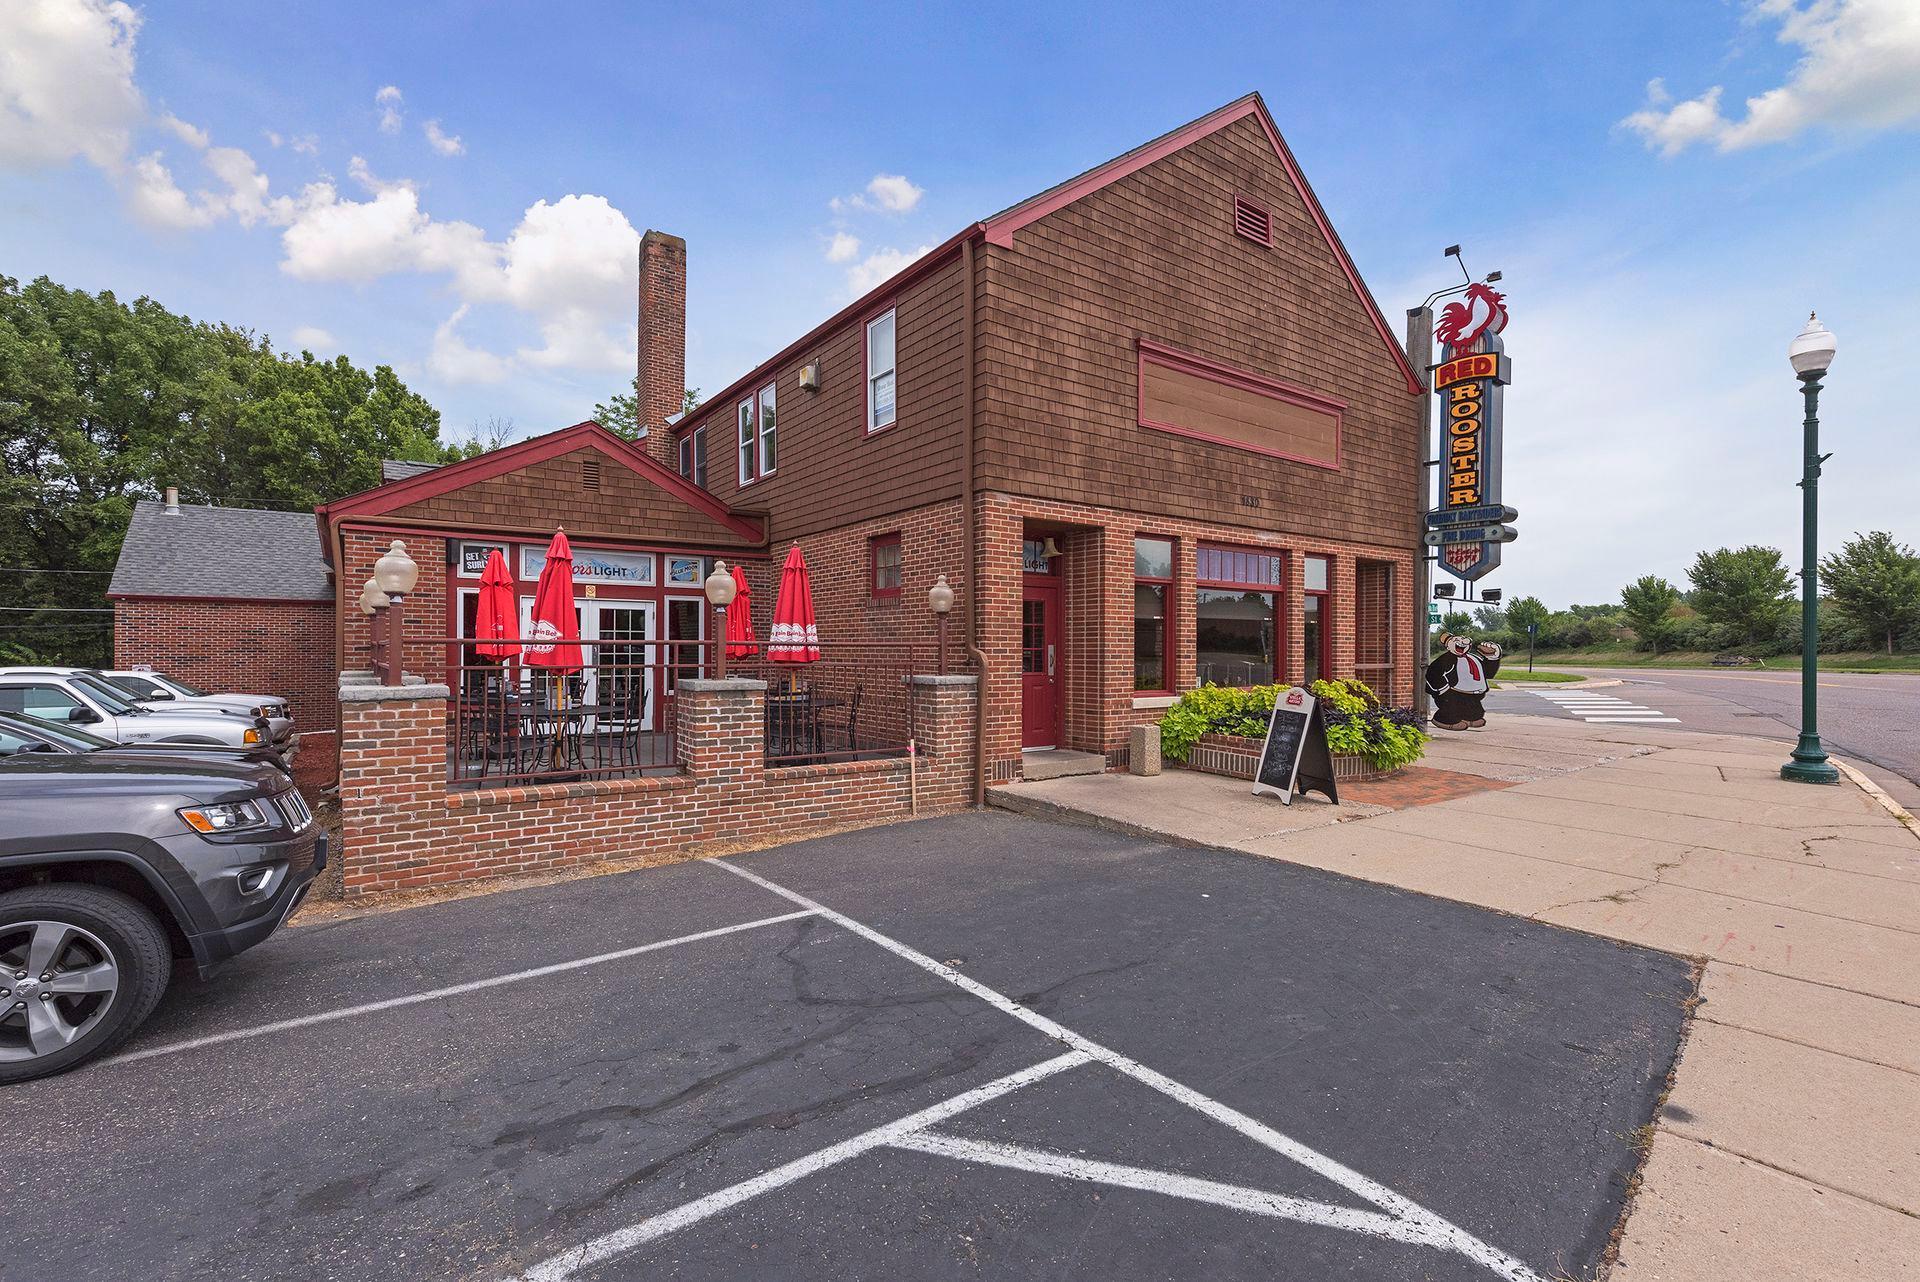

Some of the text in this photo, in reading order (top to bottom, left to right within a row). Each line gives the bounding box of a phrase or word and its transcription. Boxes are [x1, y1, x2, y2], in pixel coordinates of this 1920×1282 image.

[1439, 356, 1492, 385] RED
[1449, 383, 1480, 505] ROOSTER
[465, 552, 479, 561] GET
[571, 564, 627, 577] ors LIGHT
